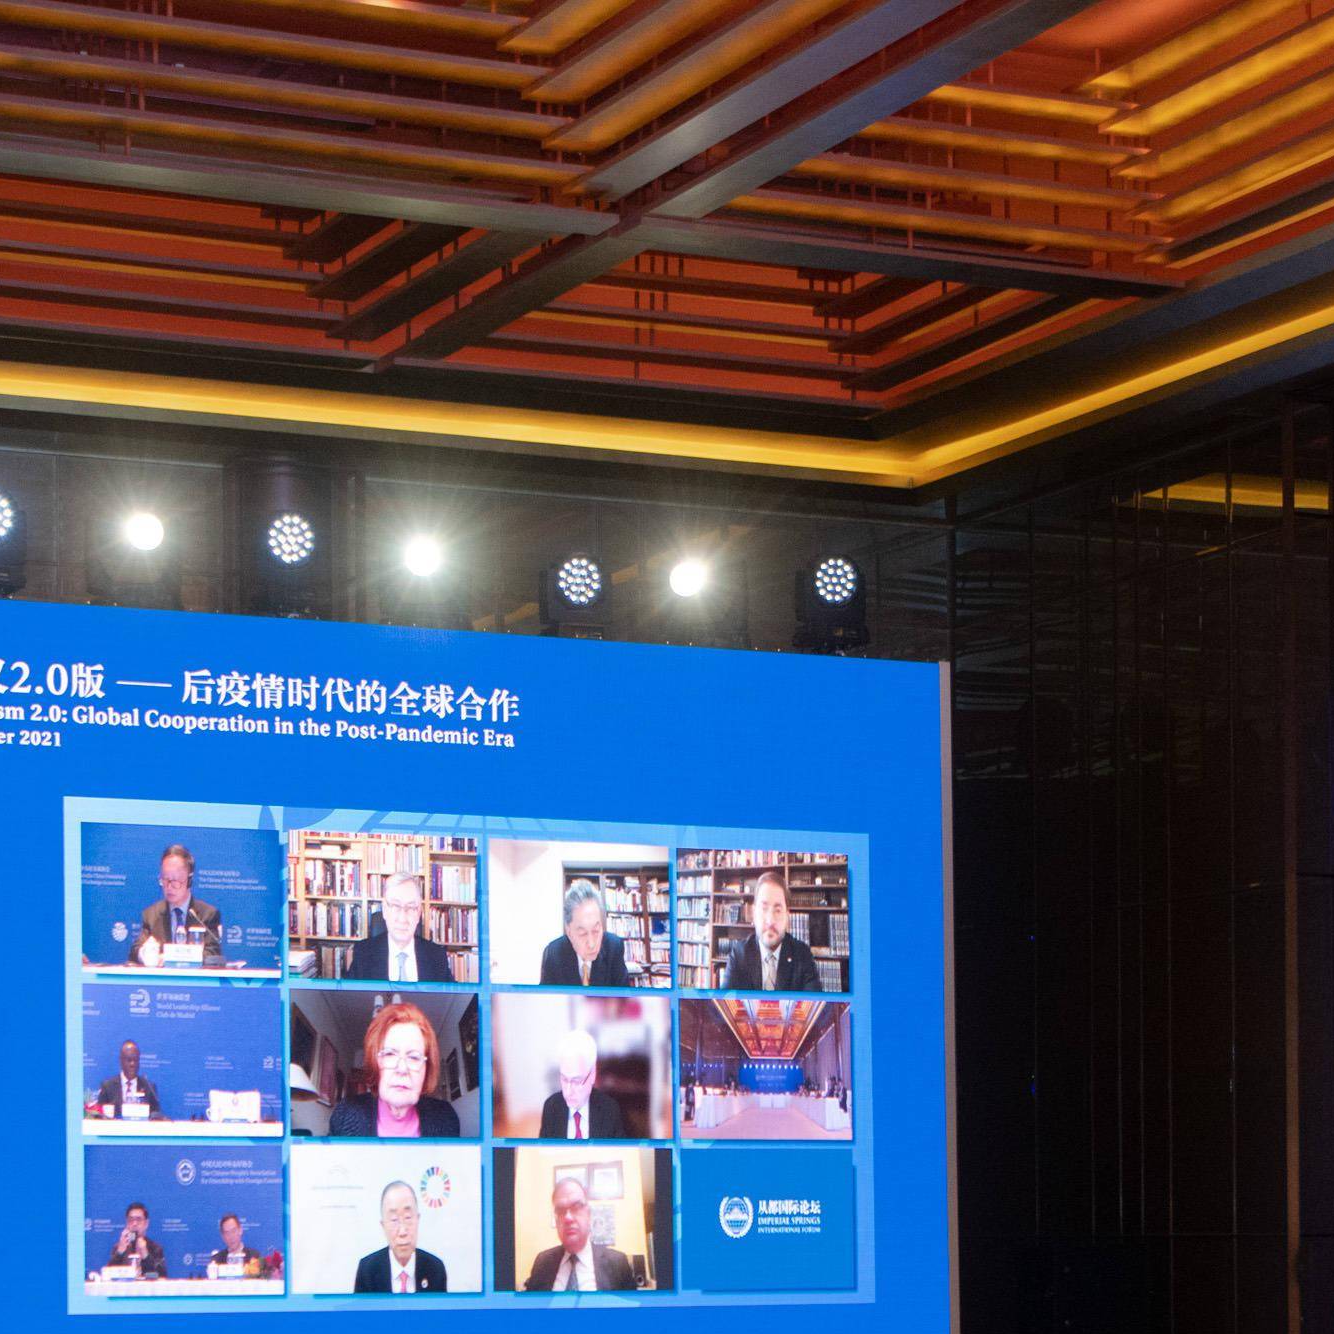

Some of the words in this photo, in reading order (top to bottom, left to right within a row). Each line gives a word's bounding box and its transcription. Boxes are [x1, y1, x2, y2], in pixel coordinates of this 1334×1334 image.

[19, 730, 62, 748] 2021
[30, 704, 68, 723] 2.0:
[72, 705, 140, 727] Global
[144, 709, 270, 734] Cooperation
[274, 716, 295, 735] in
[299, 718, 331, 737] the
[335, 720, 479, 746] Post-Pandemic
[483, 729, 515, 748] Era
